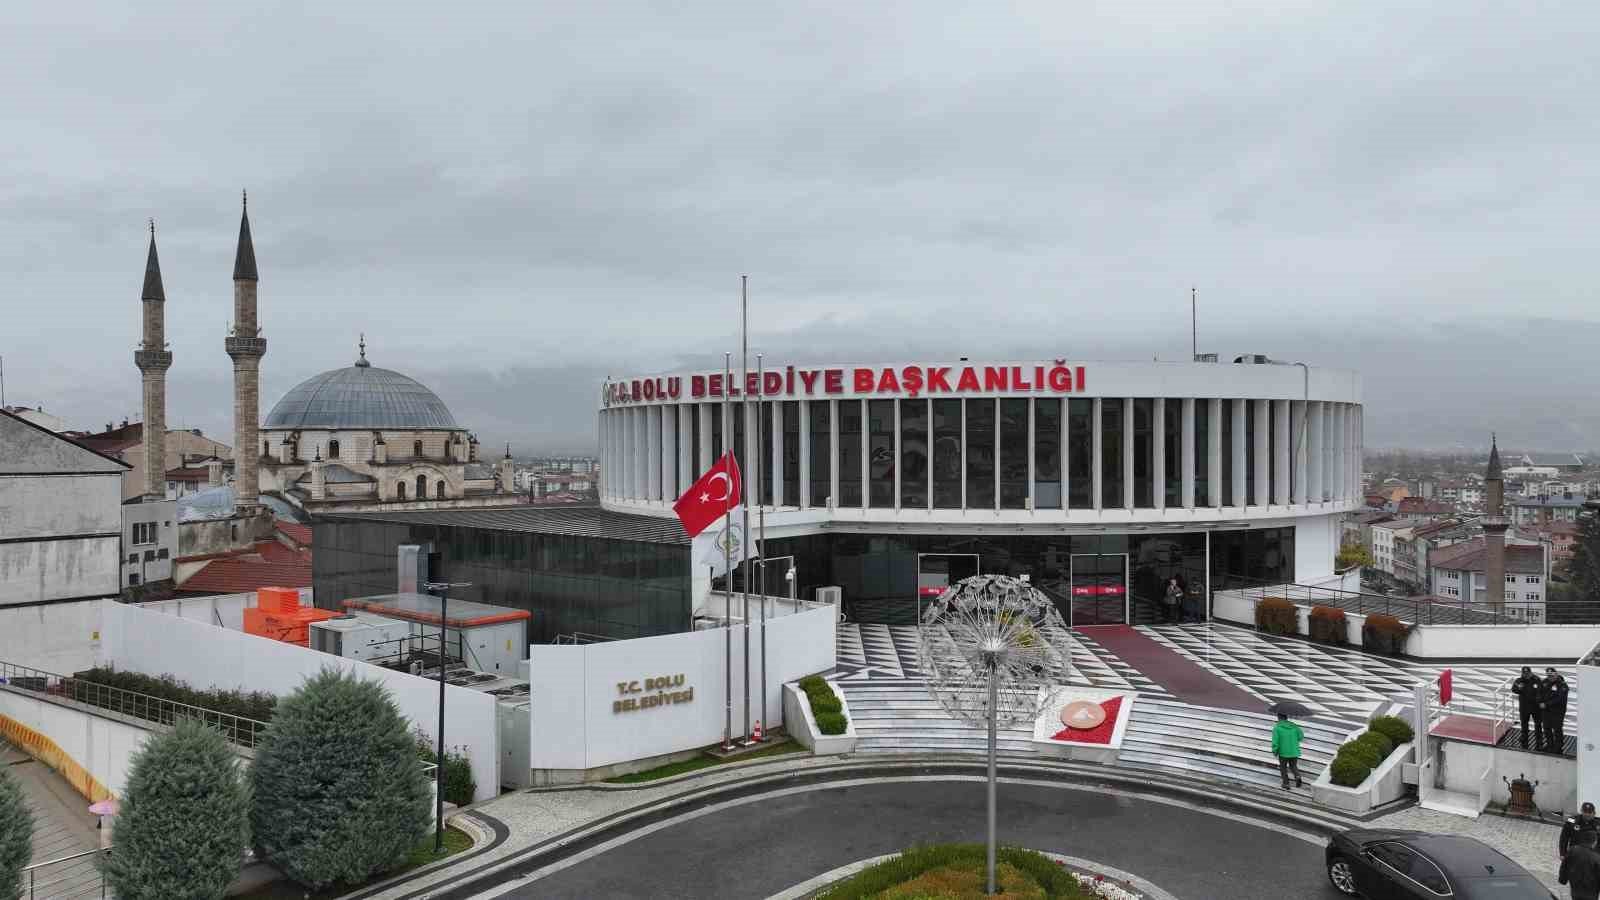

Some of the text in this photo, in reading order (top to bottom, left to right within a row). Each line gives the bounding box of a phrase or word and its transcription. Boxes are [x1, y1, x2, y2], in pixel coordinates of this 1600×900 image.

[631, 376, 681, 401] BOLU
[691, 366, 843, 397] BELEDİYE
[854, 359, 1085, 397] BAŞKANLIĞI
[645, 674, 684, 690] BOLU
